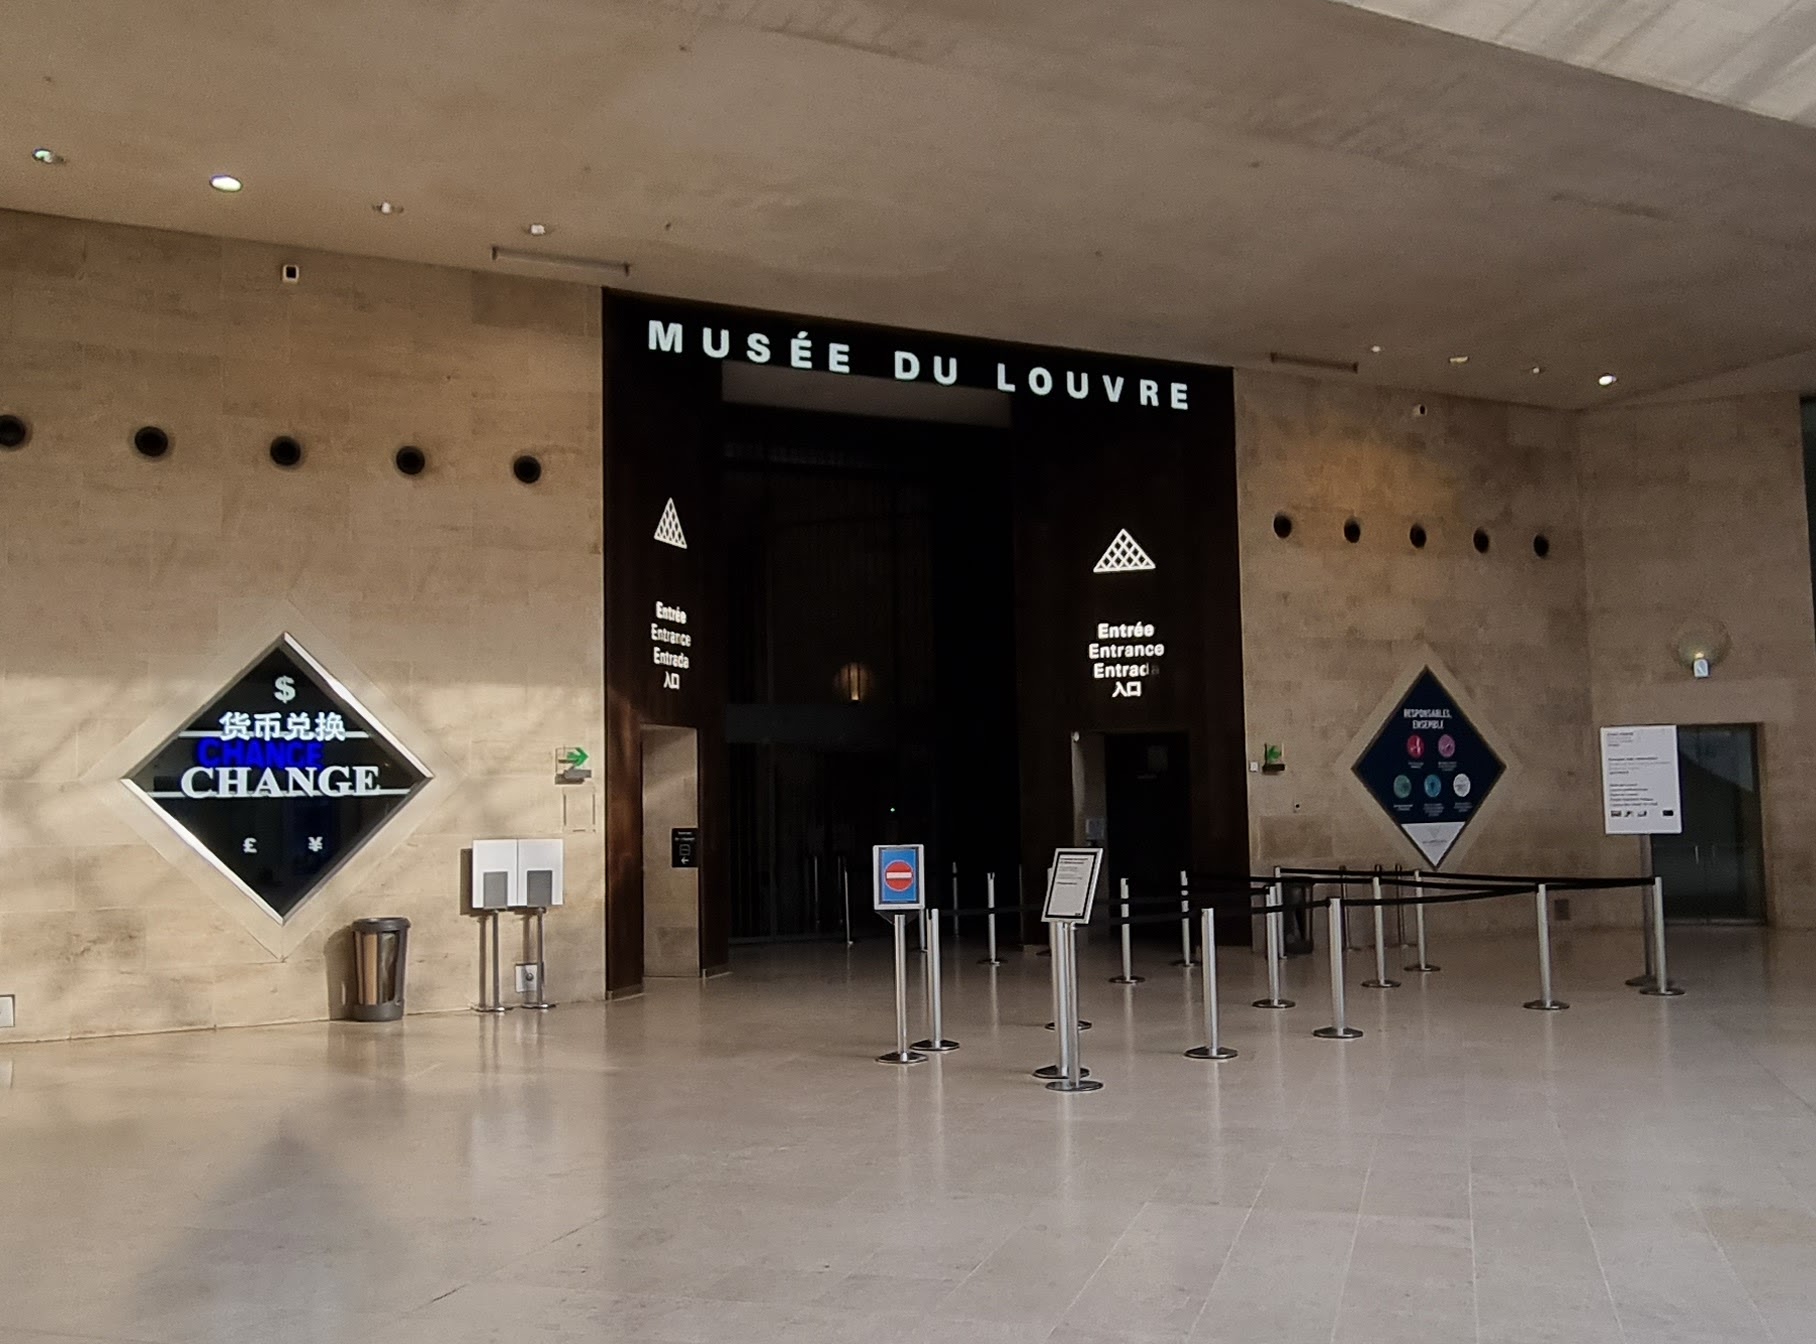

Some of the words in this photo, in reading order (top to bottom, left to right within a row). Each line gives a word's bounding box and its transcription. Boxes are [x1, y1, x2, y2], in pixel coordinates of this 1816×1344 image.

[648, 319, 850, 374] MUSÉE
[894, 350, 958, 386] DU
[997, 362, 1189, 411] LOUVRE
[656, 600, 687, 624] Entrée
[650, 623, 692, 647] Entrance
[1097, 620, 1155, 639] Entrée
[653, 646, 690, 669] Entrada
[1088, 643, 1165, 659] Entrance
[273, 675, 296, 704] $
[663, 670, 680, 690] 入口
[1111, 680, 1142, 698] 入口
[219, 711, 346, 742] 货币兑换
[196, 736, 325, 770] CHANGE
[180, 765, 382, 799] CHANGE
